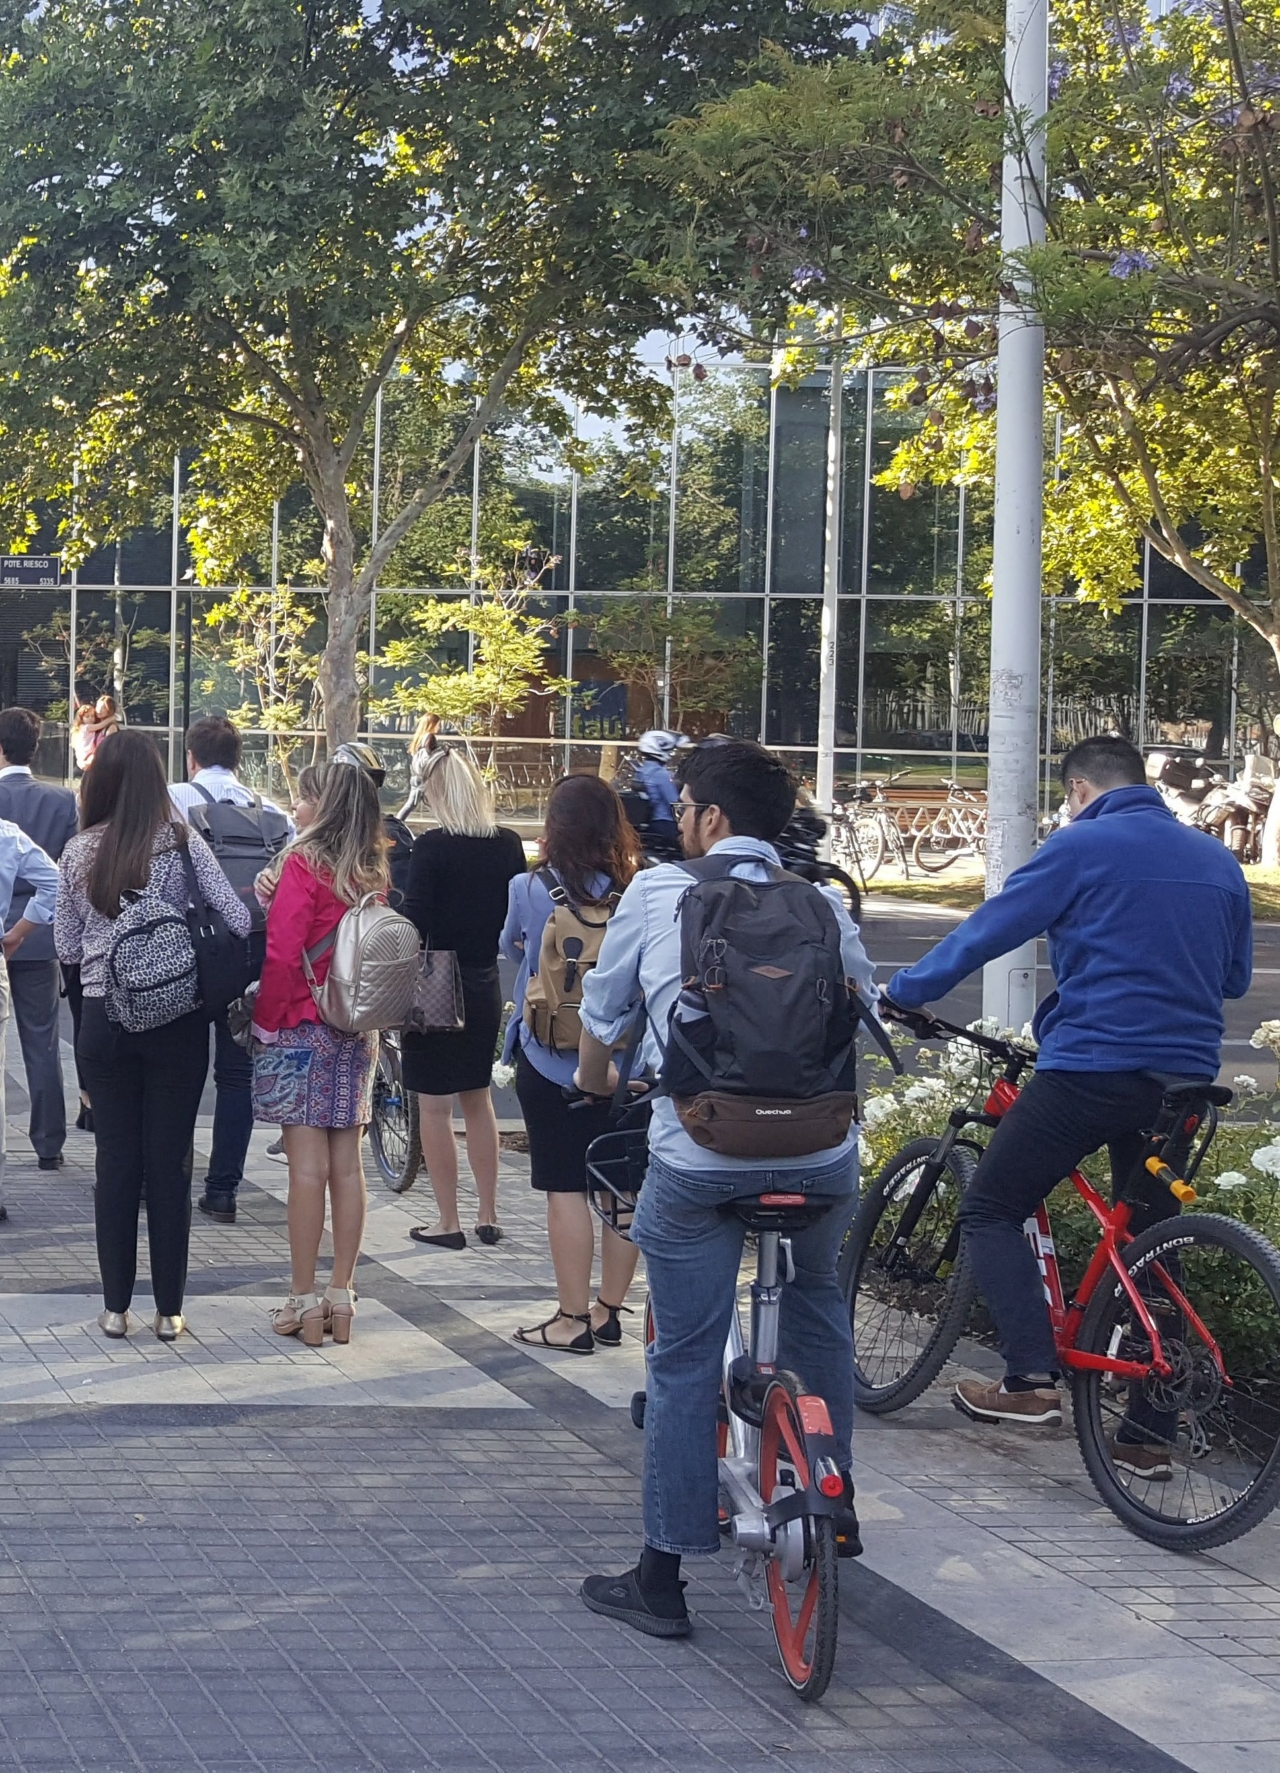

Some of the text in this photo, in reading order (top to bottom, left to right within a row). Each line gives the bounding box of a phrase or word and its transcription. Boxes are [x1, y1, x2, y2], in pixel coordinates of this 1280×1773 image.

[23, 560, 48, 568] RIESCO
[883, 1155, 929, 1196] ONTRAGER
[1114, 1236, 1195, 1297] BONTRAGR
